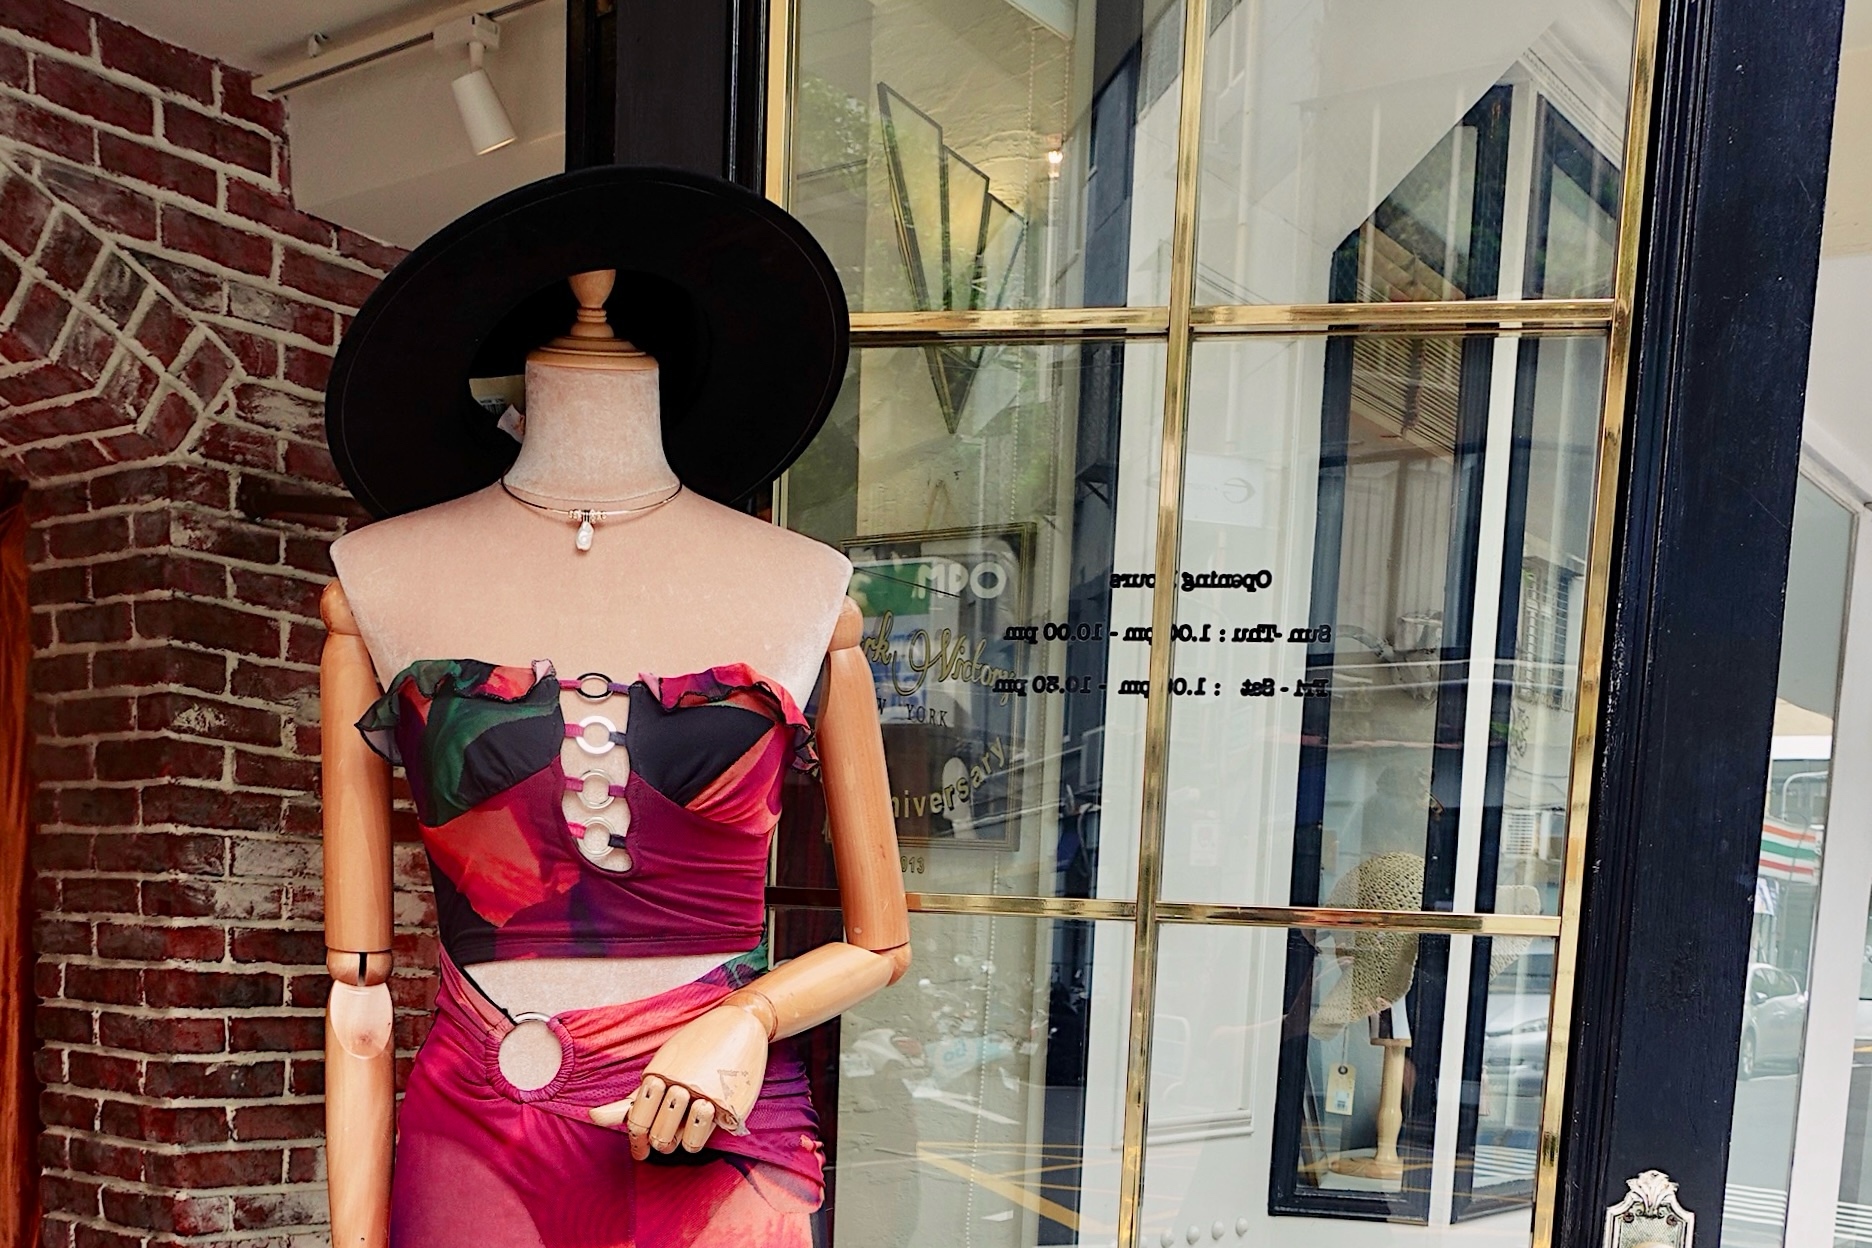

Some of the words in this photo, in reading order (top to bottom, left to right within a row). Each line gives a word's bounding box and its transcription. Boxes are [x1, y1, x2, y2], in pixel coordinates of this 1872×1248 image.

[861, 610, 893, 666] rk
[905, 703, 949, 729] YORK
[890, 736, 1006, 819] niversary
[900, 855, 926, 875] 013
